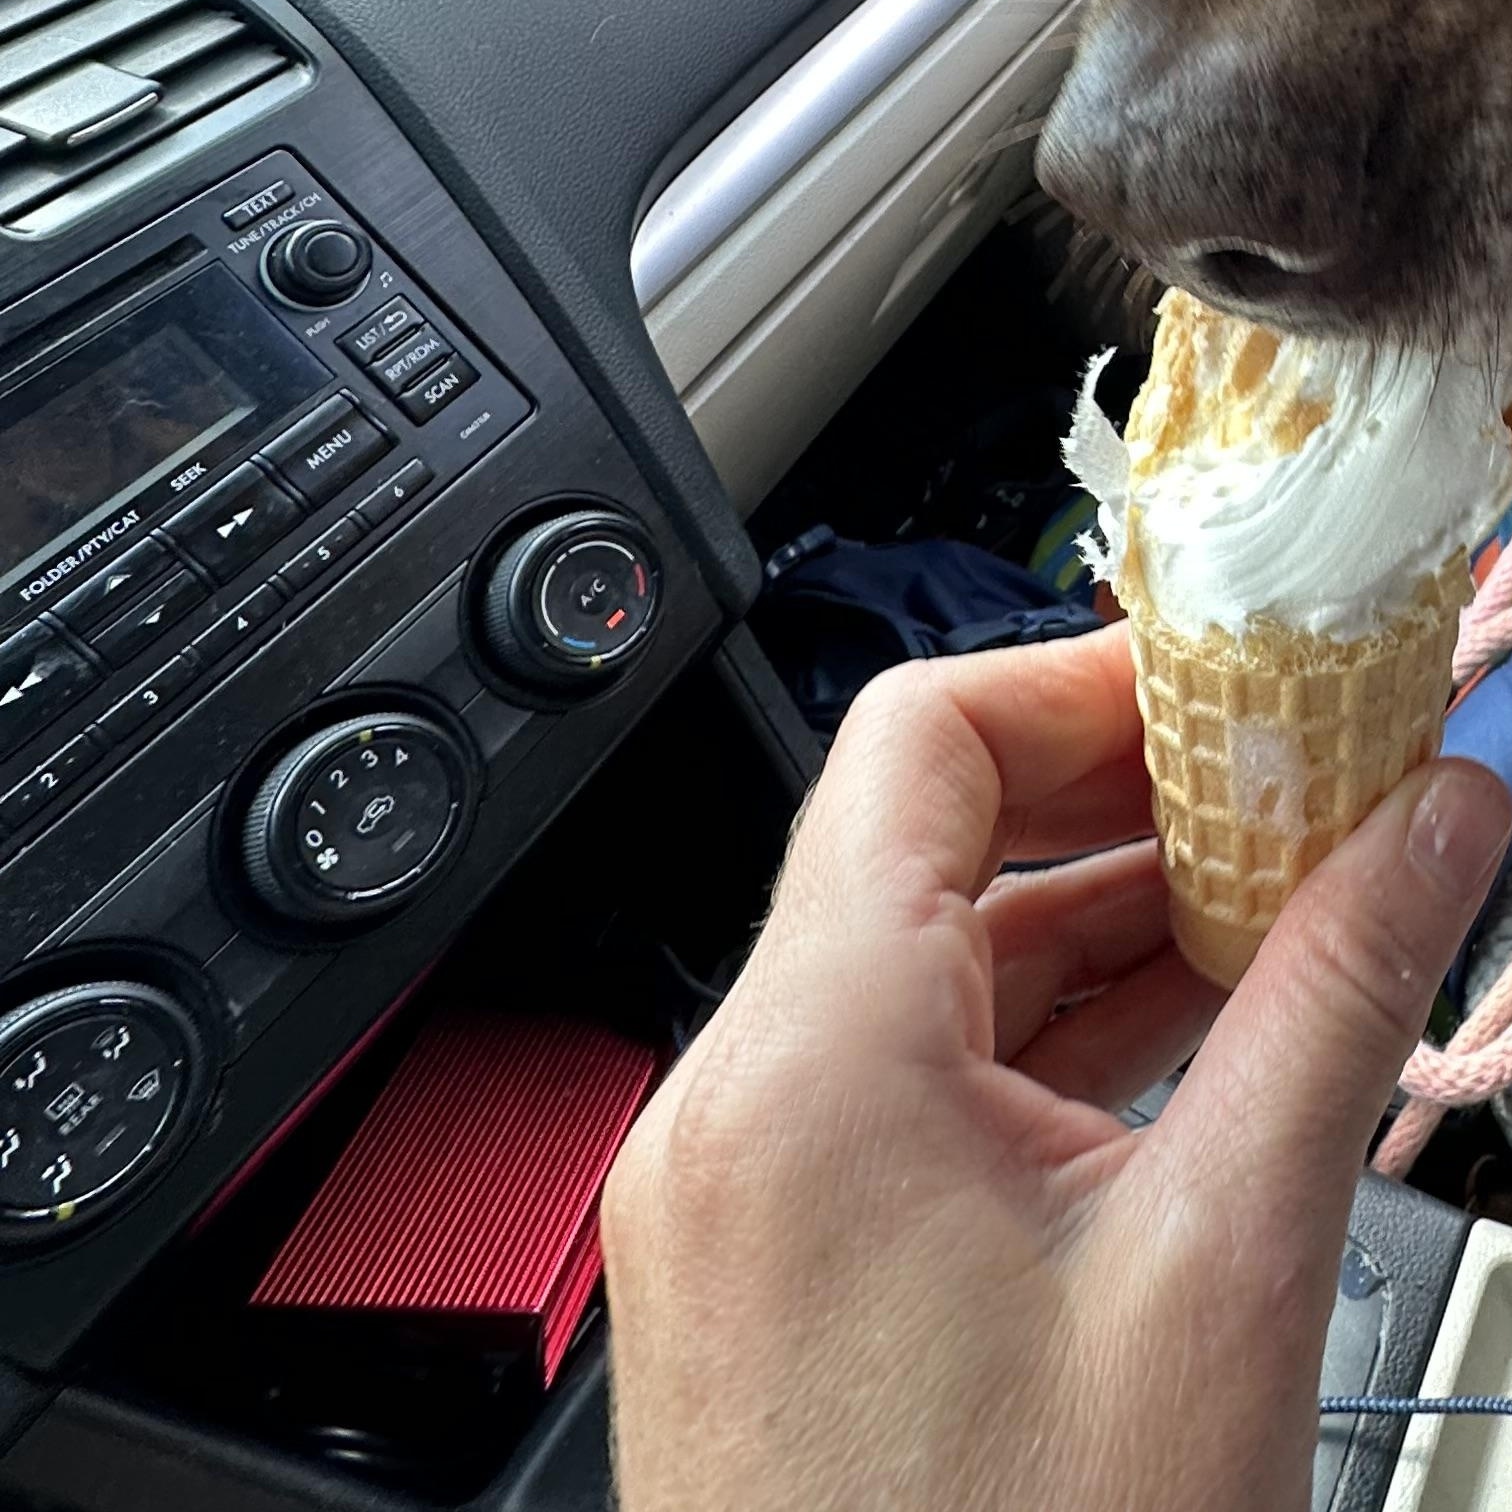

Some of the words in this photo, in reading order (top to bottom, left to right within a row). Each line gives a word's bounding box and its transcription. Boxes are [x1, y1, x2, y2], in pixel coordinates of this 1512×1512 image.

[241, 191, 278, 218] TEXT
[227, 192, 322, 255] TUNE/TRACK/CH
[384, 338, 441, 381] RPT/RDM
[424, 373, 460, 404] SCAN
[306, 429, 352, 470] MENU
[170, 462, 207, 492] SEEK
[394, 486, 404, 498] 6
[19, 509, 142, 601] FOLDER/PTY/CAT
[317, 546, 331, 560] 5
[580, 578, 606, 607] A/C
[237, 616, 249, 631] 4
[143, 690, 159, 705] 3
[360, 749, 379, 768] 3
[395, 747, 409, 767] 4
[40, 772, 59, 788] 2
[330, 769, 349, 789] 2
[310, 800, 327, 815] 1
[305, 829, 324, 848] 0
